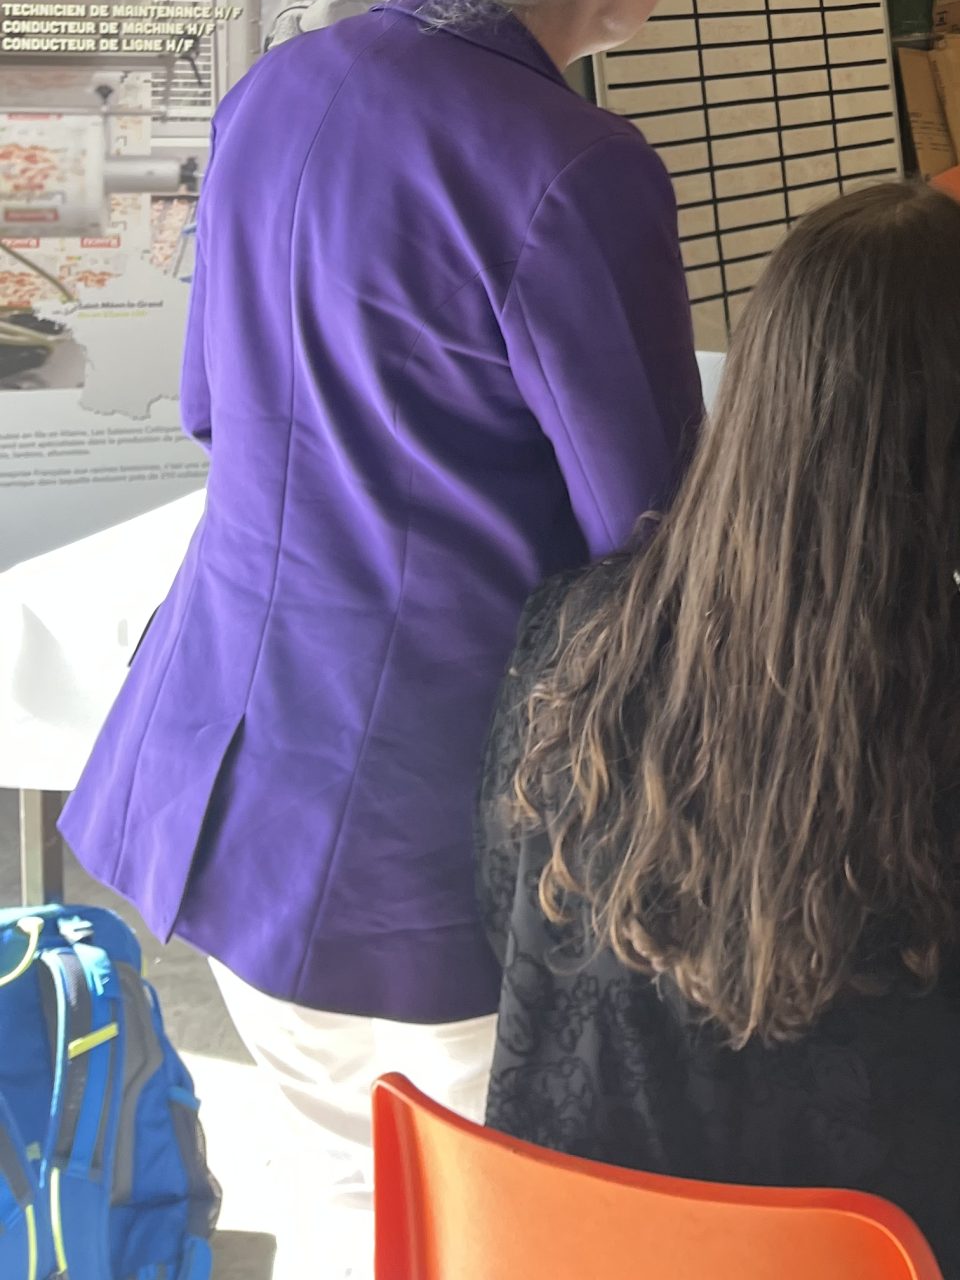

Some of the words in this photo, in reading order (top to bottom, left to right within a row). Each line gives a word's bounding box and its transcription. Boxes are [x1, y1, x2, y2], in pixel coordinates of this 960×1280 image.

[2, 3, 87, 17] TECHNICIEN
[90, 4, 109, 18] DE
[112, 4, 212, 19] MAINTENANCE
[214, 7, 244, 20] H/F
[2, 20, 97, 34] CONDUCTEUR
[100, 22, 119, 35] DE
[122, 22, 184, 35] MACHINE
[187, 23, 217, 36] H/F
[2, 37, 97, 51] CONDUCTEUR
[100, 38, 119, 52] DE
[122, 38, 163, 52] LIGNE
[165, 38, 195, 53] H/F
